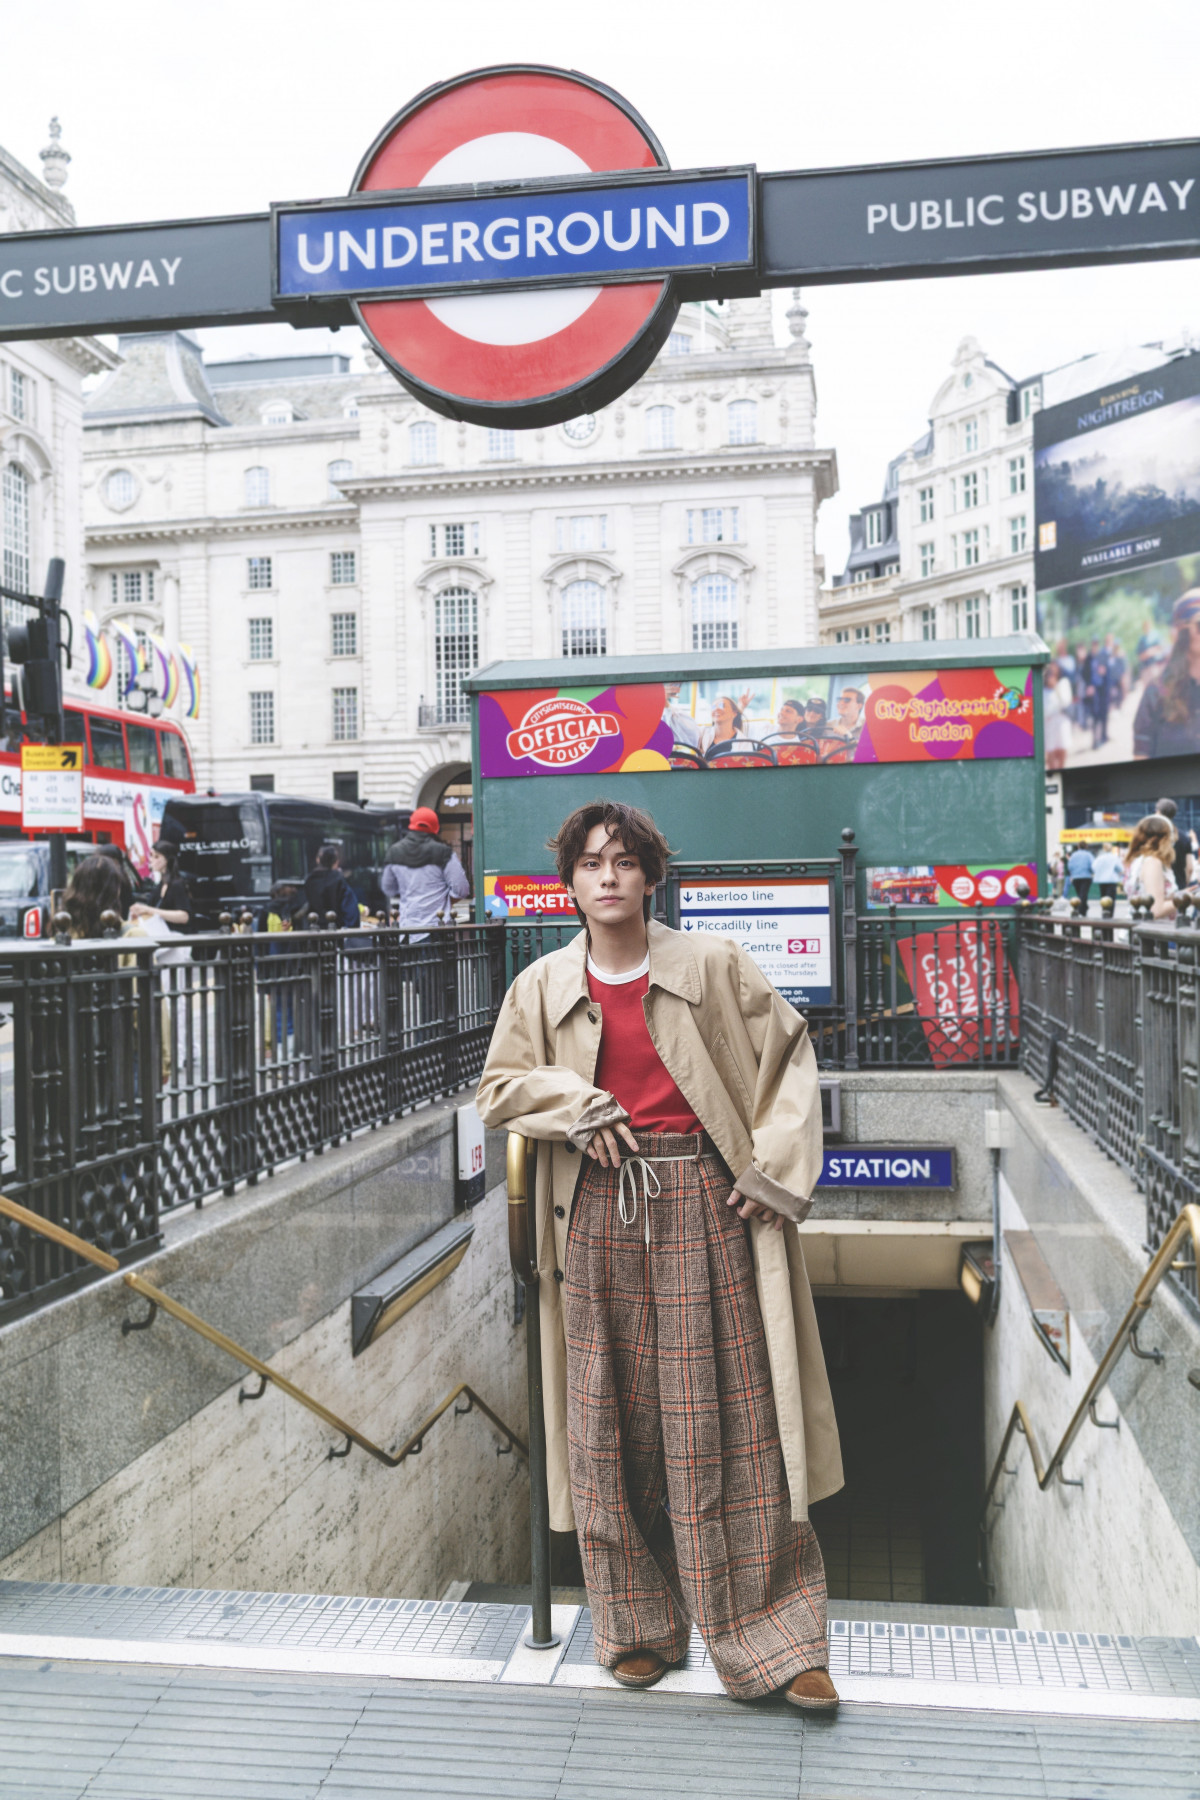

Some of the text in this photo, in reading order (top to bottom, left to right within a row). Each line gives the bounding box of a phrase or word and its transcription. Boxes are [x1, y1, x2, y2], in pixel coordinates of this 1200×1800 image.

[867, 179, 1195, 234] PUBLIC SUBWAY
[298, 202, 730, 274] UNDERGROUND
[34, 257, 182, 296] SUBWAY
[1077, 387, 1164, 429] NIGHTREIGN
[1081, 537, 1161, 566] AVAILABLE NOW
[530, 702, 587, 724] CITYSIGHTSEEING
[518, 717, 612, 752] OFFICIAL
[909, 721, 973, 742] London
[548, 741, 591, 761] TOUR
[505, 882, 567, 892] HOP-ON HOP-
[697, 890, 774, 902] Bakerloo line
[697, 919, 779, 932] Piccadilly line
[742, 942, 783, 952] Centre
[784, 969, 818, 977] Thursdays
[800, 961, 817, 969] after
[789, 996, 810, 1004] nights
[921, 953, 962, 1043] CLOSED
[472, 1144, 482, 1173] LFB
[828, 1158, 931, 1179] STATION
